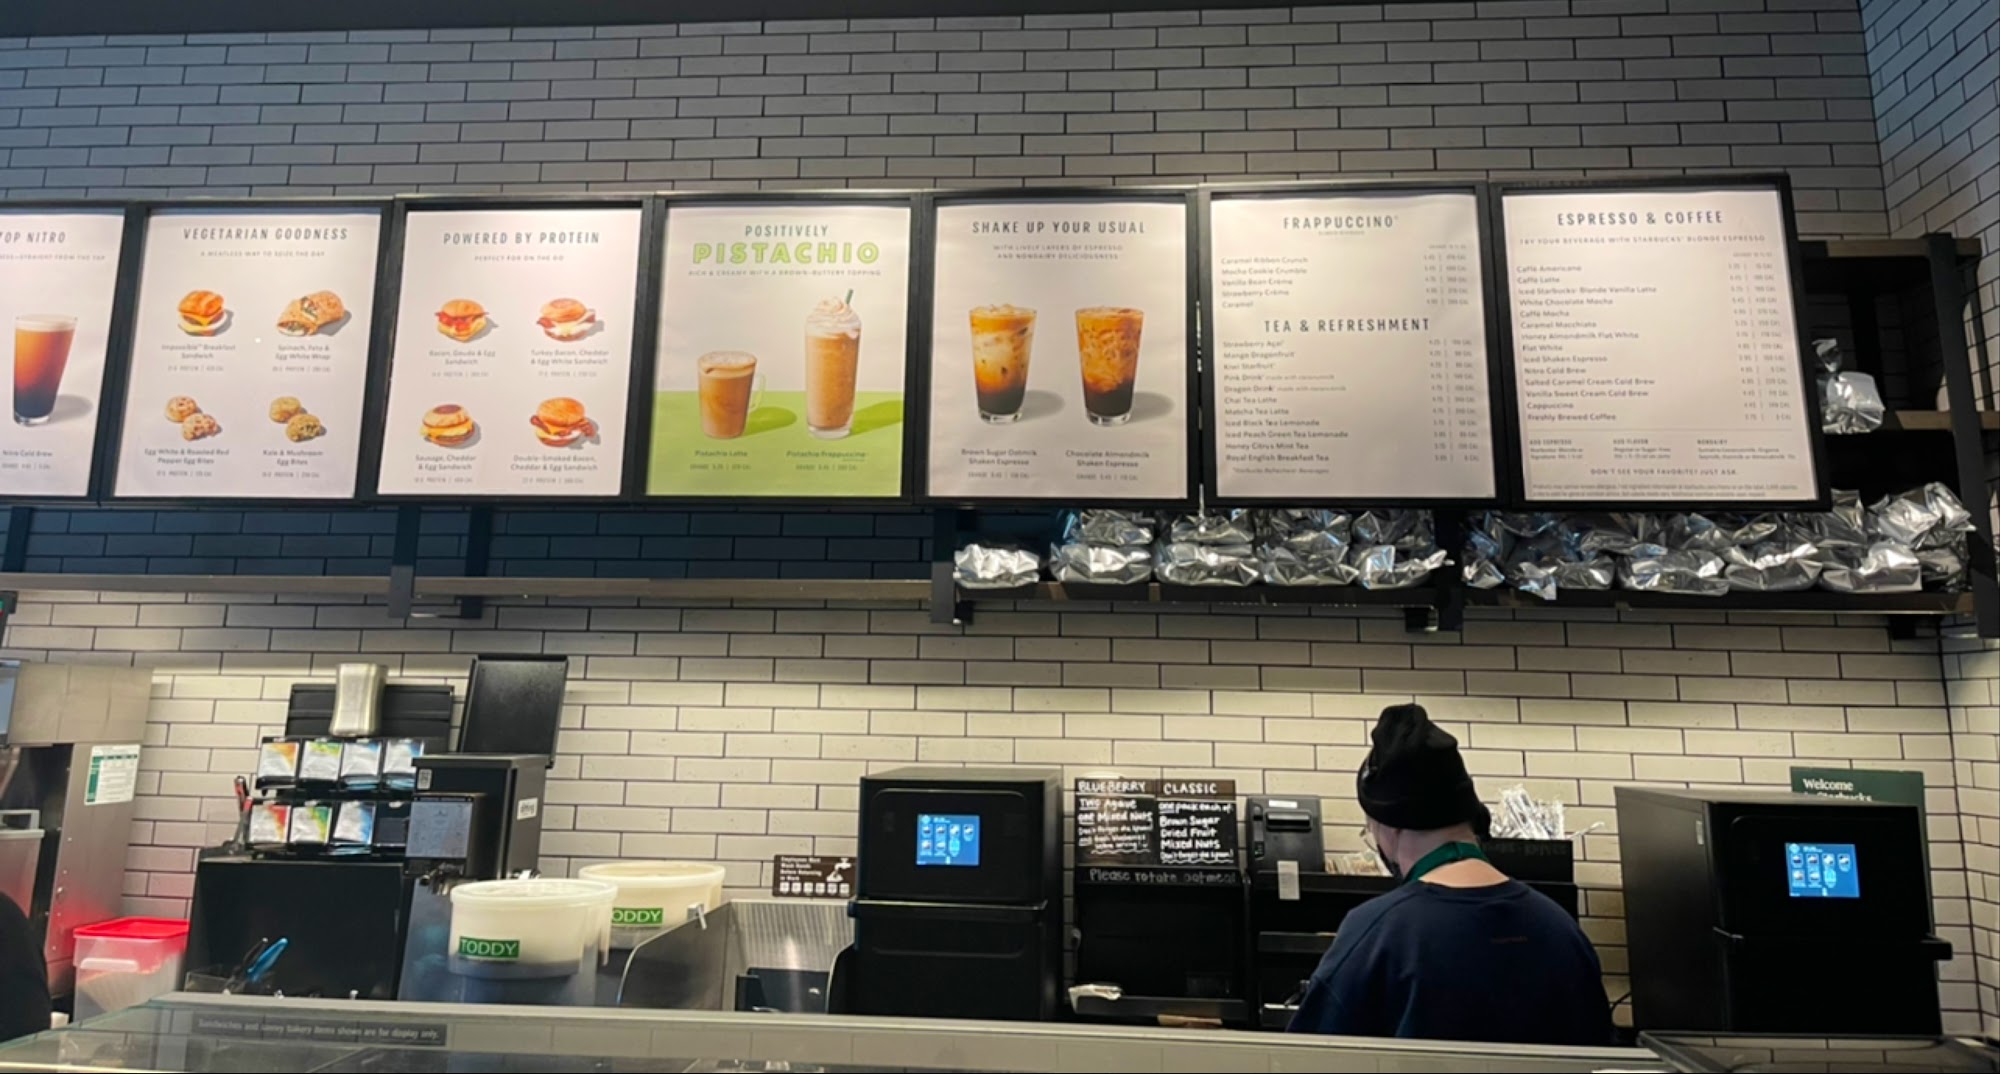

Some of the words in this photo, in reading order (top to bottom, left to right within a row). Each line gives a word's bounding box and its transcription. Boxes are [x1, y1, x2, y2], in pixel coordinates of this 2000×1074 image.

[1283, 215, 1394, 230] FRAPPUCCINO
[1558, 212, 1637, 226] ESPRESSO
[1646, 212, 1656, 225] &
[1664, 211, 1723, 224] COFFEE
[745, 225, 829, 237] POSITIVELY
[972, 221, 1018, 233] SHAKE
[1026, 221, 1044, 233] UP
[1052, 221, 1090, 233] YOUR
[1098, 221, 1145, 233] USUAL
[26, 231, 66, 244] NITRO
[183, 228, 268, 241] VEGETARIAN
[274, 228, 348, 241] GOODNESS
[443, 232, 508, 245] POWERED
[514, 232, 531, 244] BY
[539, 232, 599, 244] PROTEIN
[692, 242, 880, 264] PISTACHIO
[1544, 298, 1584, 306] Chocolate
[1585, 298, 1613, 306] Mocha
[1264, 320, 1291, 333] TEA
[1299, 320, 1308, 332] &
[1317, 318, 1430, 332] REFRESHMENT
[1520, 321, 1554, 329] Caramel
[1521, 333, 1547, 342] Honey
[1548, 332, 1596, 340] Almondmilk
[1572, 355, 1608, 365] Espresso
[1524, 367, 1545, 375] Nitro
[1525, 378, 1550, 386] Salted
[1551, 378, 1585, 386] Caramel
[1586, 378, 1613, 386] Cream
[1526, 390, 1553, 398] Vanilla
[1553, 390, 1579, 398] Sweet
[1527, 402, 1574, 411] Cappuccino
[1279, 419, 1320, 427] Lemonade
[1527, 414, 1556, 423] Freshly
[1556, 413, 1588, 421] Brewed
[1589, 413, 1617, 421] Coffee
[1225, 443, 1249, 452] Honey
[1226, 454, 1246, 463] Royal
[1248, 454, 1275, 463] English
[1276, 454, 1314, 462] Breakfast
[1315, 454, 1329, 462] Tea
[1104, 460, 1139, 470] Espresso
[1078, 781, 1146, 793] BLUEBERRY
[1163, 782, 1217, 795] CLASSIC
[1802, 778, 1854, 791] Welcome
[1159, 815, 1188, 827] Brown
[1189, 815, 1220, 829] Sugar
[1160, 828, 1188, 838] Dried
[1190, 828, 1217, 838] Fruit
[1160, 839, 1192, 849] Mixed
[1090, 869, 1130, 881] Please
[1135, 872, 1177, 883] rotate
[1184, 873, 1236, 883] oatmeal
[612, 910, 662, 922] ODDY
[461, 940, 517, 956] TODDY
